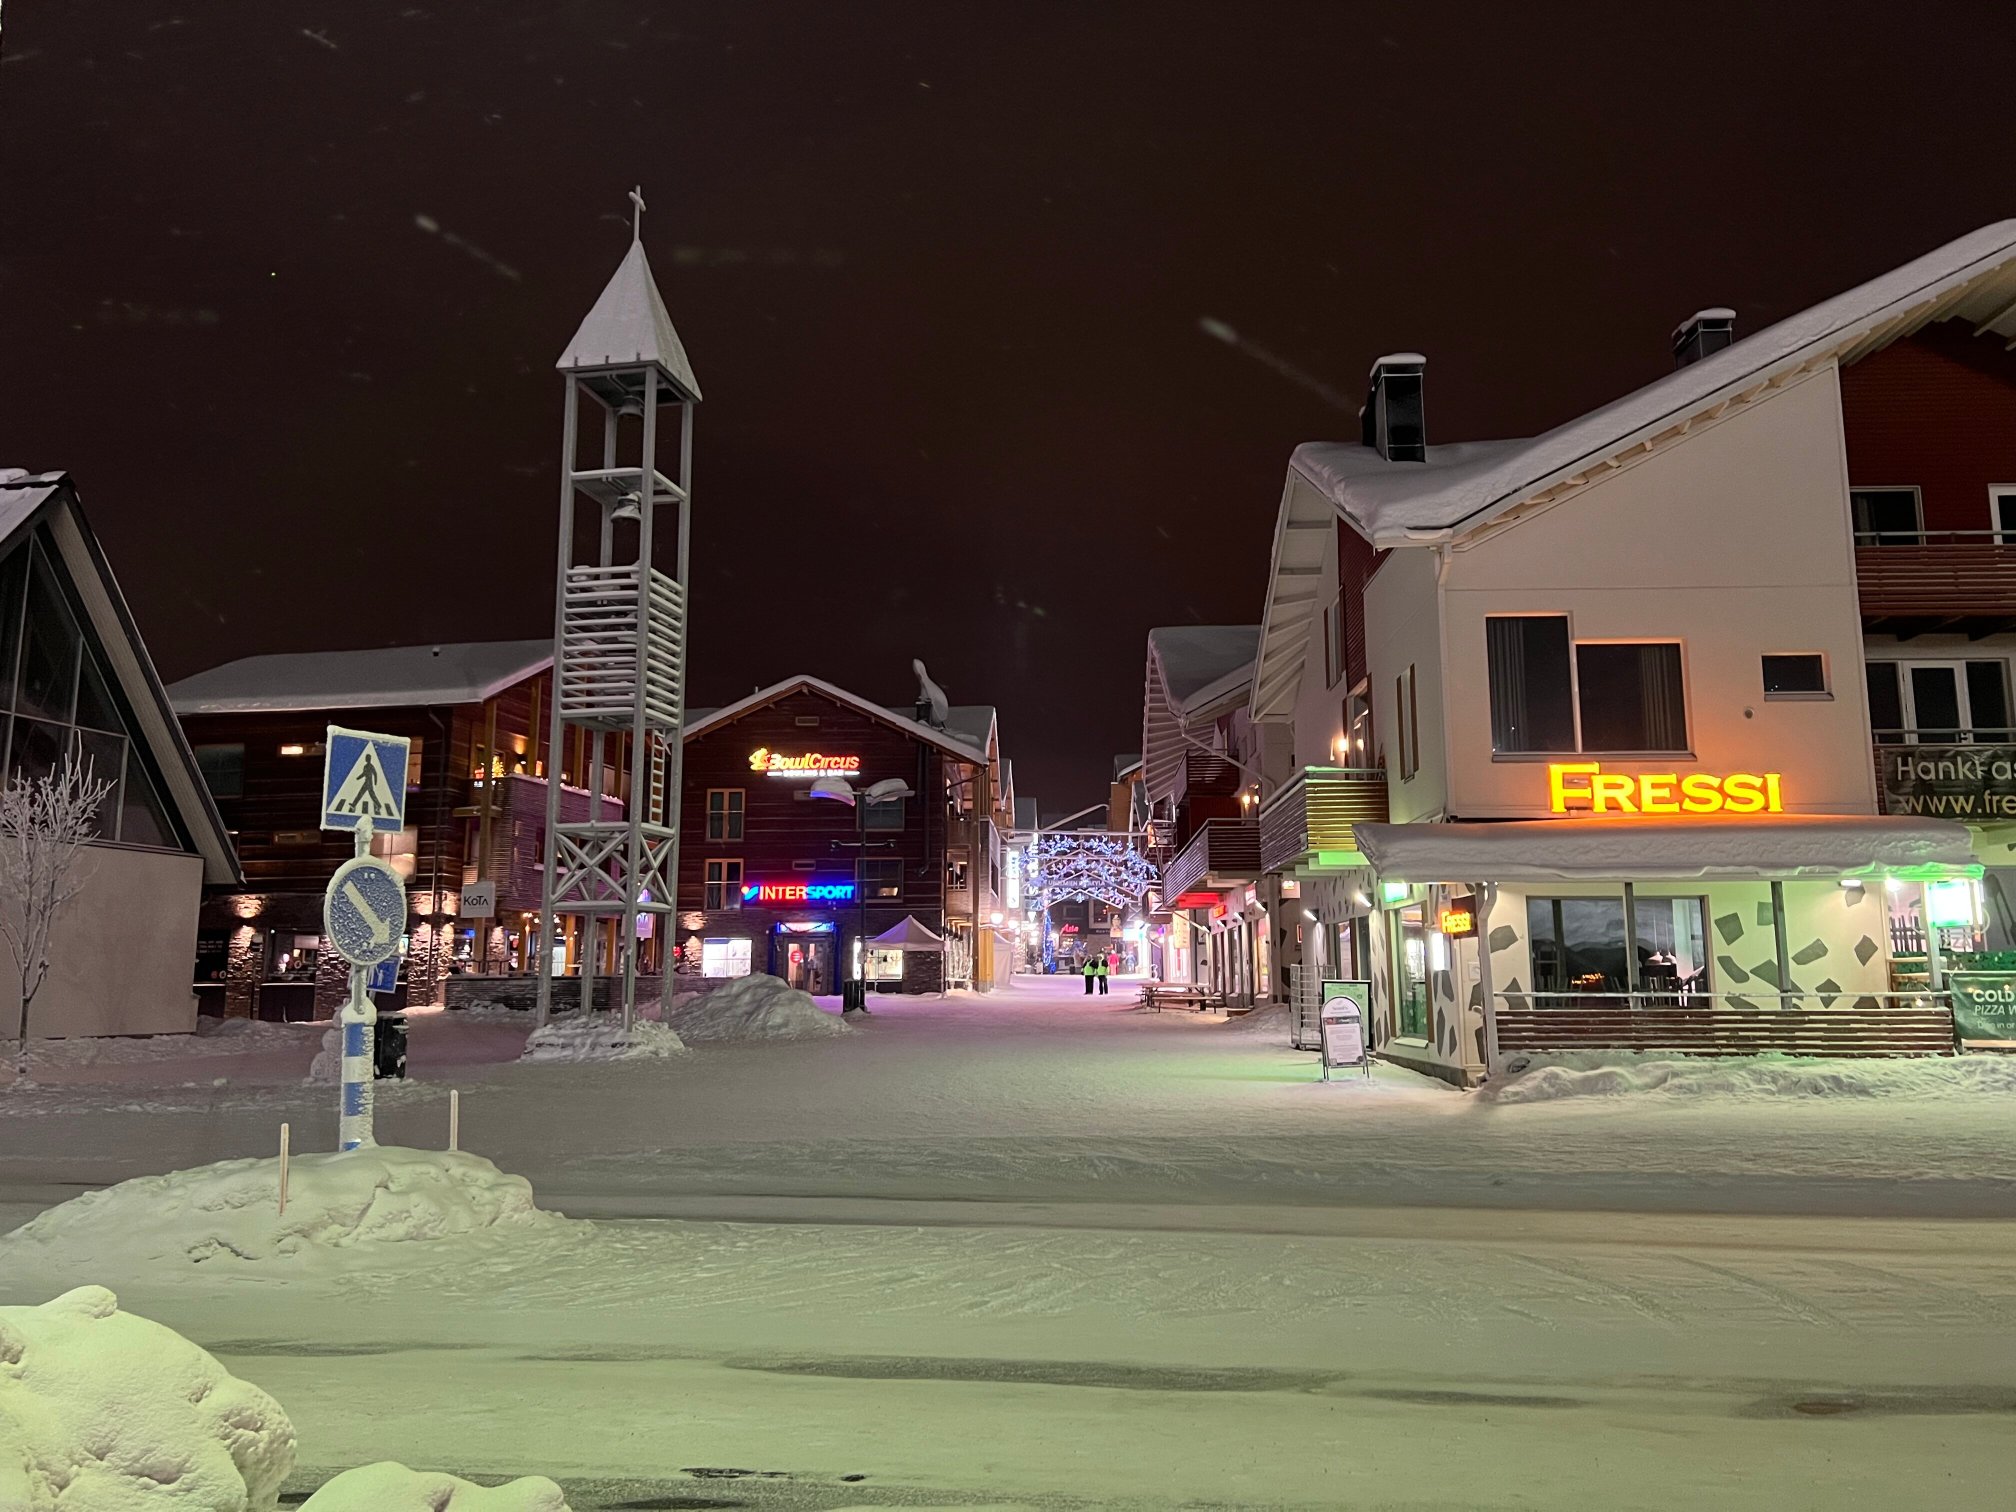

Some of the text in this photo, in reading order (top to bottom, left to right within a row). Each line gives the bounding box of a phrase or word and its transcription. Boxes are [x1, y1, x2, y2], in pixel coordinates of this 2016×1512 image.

[767, 753, 860, 769] BowlCircus
[1549, 762, 1783, 813] FRESSI
[759, 886, 854, 900] INTERSPORT
[1972, 989, 2015, 1003] COLD
[1974, 1004, 2005, 1016] PIZZA
